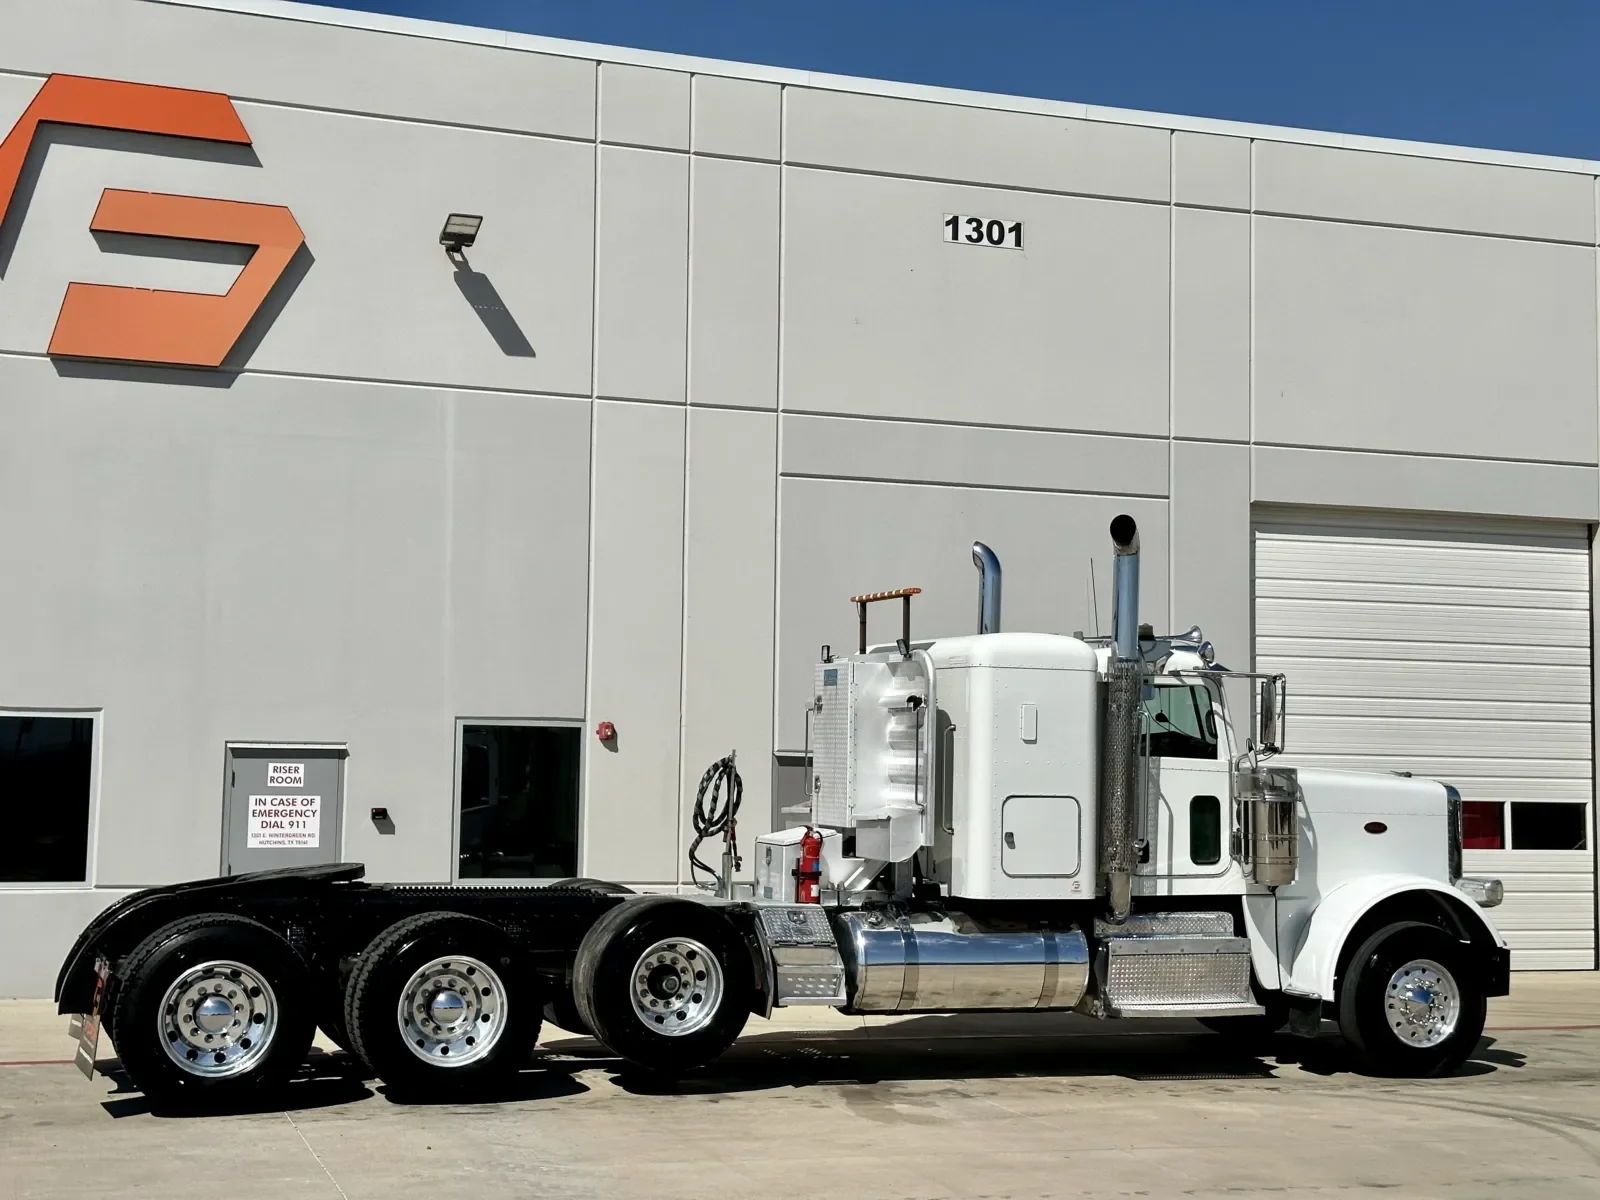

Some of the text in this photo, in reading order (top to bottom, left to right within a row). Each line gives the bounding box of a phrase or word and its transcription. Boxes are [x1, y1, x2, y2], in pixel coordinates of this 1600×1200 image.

[945, 215, 1022, 248] 1301
[272, 765, 300, 774] RISER
[269, 776, 302, 785] ROOM
[254, 798, 316, 807] IN CASE OF
[252, 809, 318, 818] EMERGENCY
[260, 820, 306, 829] DIAL 911
